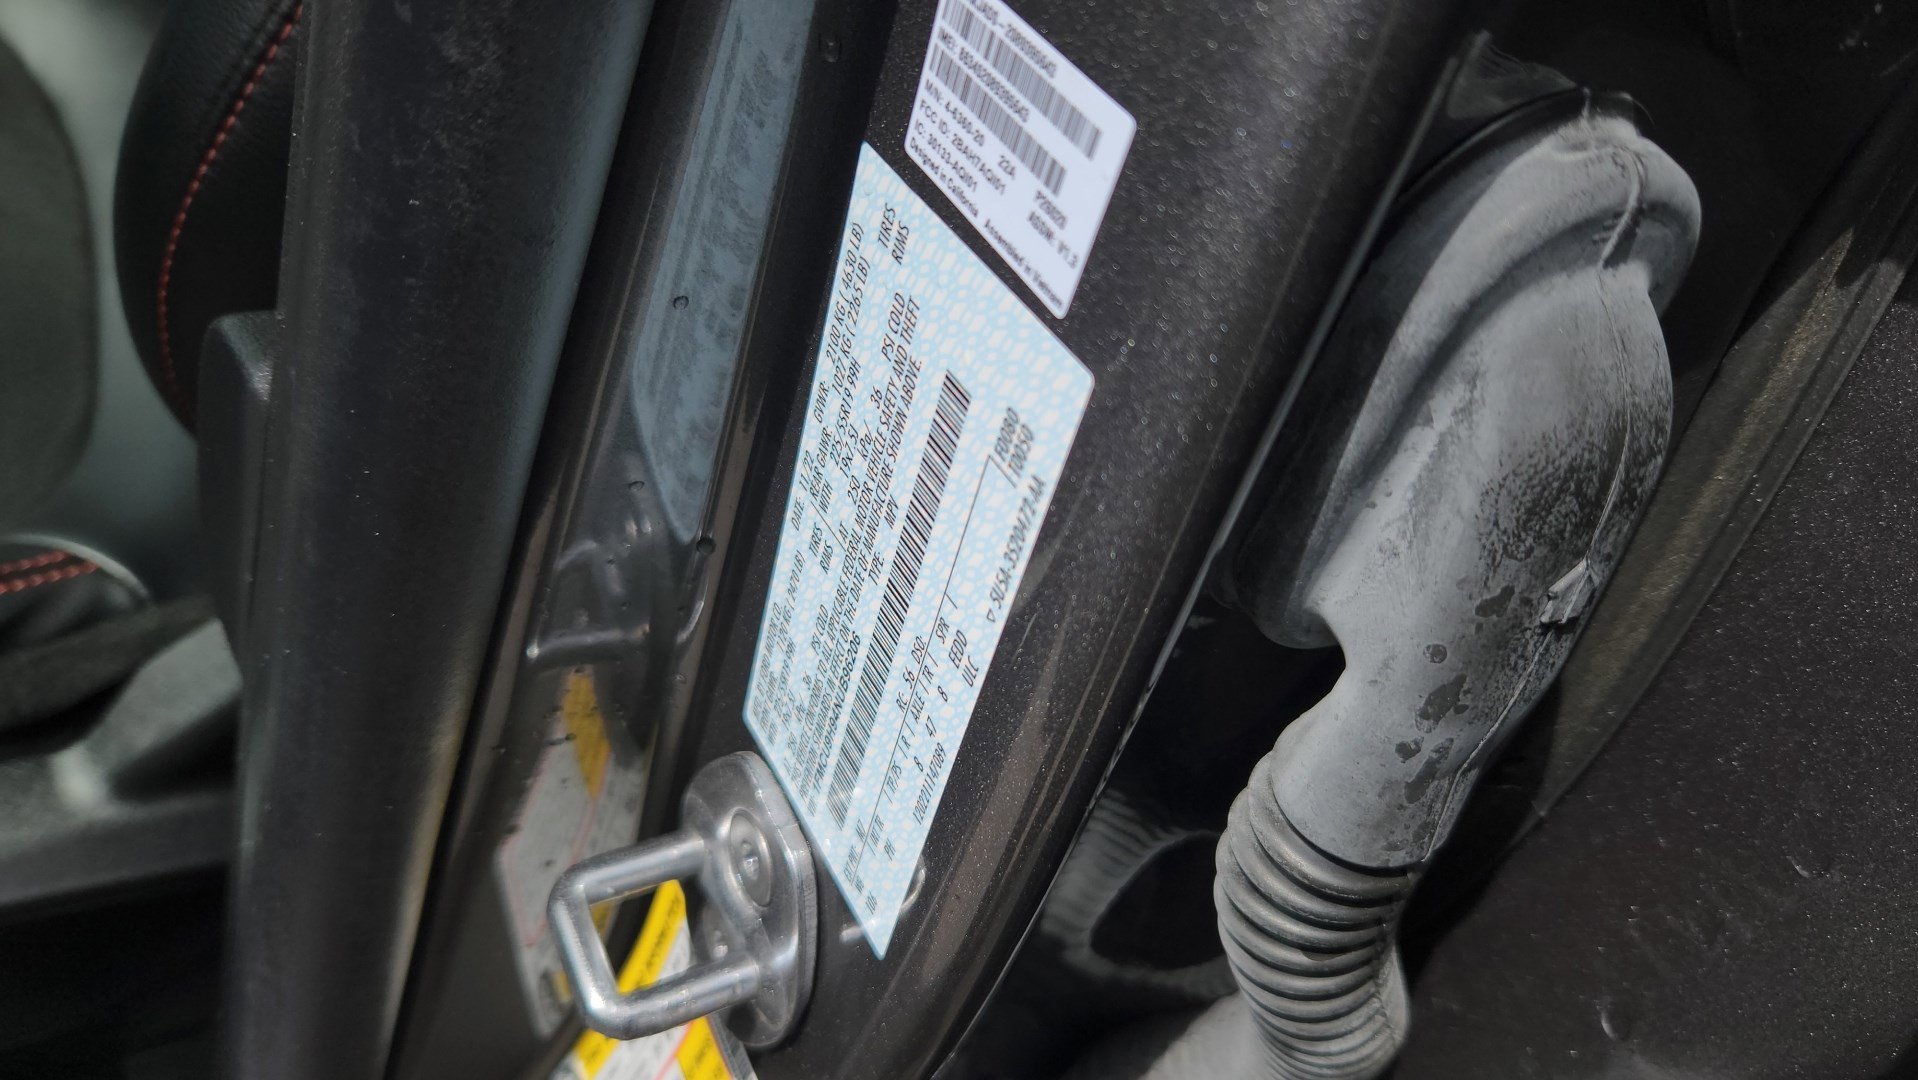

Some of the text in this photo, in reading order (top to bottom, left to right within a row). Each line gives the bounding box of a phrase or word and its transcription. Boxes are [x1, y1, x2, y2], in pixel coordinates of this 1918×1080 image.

[913, 117, 927, 140] IC:
[918, 97, 938, 126] FCC
[937, 116, 952, 140] ID:
[923, 77, 945, 107] M/N:
[996, 151, 1018, 181] 22A
[908, 135, 941, 179] Designed
[938, 167, 948, 184] in
[945, 175, 979, 219] California
[983, 216, 1025, 269] Assembled
[848, 218, 864, 253] LB)
[840, 246, 858, 293] 4630
[855, 252, 871, 287] LB)
[833, 298, 846, 327] KG
[846, 280, 864, 328] 2265
[818, 200, 896, 516] WITH 225/55R19 99H TIRES
[825, 321, 841, 366] 2100
[838, 218, 910, 480] 19x7.5J RIMS
[839, 331, 853, 361] KG
[831, 355, 847, 398] 1027
[812, 375, 830, 426] GVWR:
[837, 289, 906, 545] AT 250 kPa/ 36 PSI COLD
[815, 419, 833, 470] GAWR:
[790, 446, 816, 532] DATE: 11/22
[808, 463, 823, 503] REAR
[789, 293, 921, 789] THIS VEHICLE CONFORMS TO ALL APPLICABLE FEDERAL MOTOR VEHICLE SAFETY AND THEFT
[819, 537, 834, 576] RIMS
[793, 546, 806, 577] LB)
[797, 349, 922, 804] PREVENTION STANDARDS IN EFFECT ON THE DATE OF MANUFACTURE SHOWN ABOVE.
[786, 566, 800, 603] 2470
[766, 715, 778, 748] WITH
[784, 634, 797, 665] 99H
[808, 519, 823, 560] TIRES
[781, 602, 792, 628] KG
[814, 601, 829, 638] COLD
[934, 613, 950, 646] SPR
[764, 613, 778, 658] MOTOR
[775, 618, 789, 655] 1120
[810, 630, 822, 657] PSI
[811, 627, 861, 796] 1FMCU9H94NUB96206
[867, 545, 885, 589] TYPE:
[882, 492, 900, 531] MPV
[758, 649, 770, 684] FORD
[802, 668, 813, 692] 36
[894, 629, 927, 715] RC: 56 DSO:
[921, 662, 934, 687] TR
[961, 654, 979, 690] ULC
[755, 675, 765, 698] BY
[758, 696, 771, 734] FRONT
[908, 689, 925, 725] AXLE
[786, 728, 798, 756] 250
[864, 888, 878, 916] 106
[883, 836, 896, 862] PH
[923, 713, 938, 742] 47
[947, 626, 968, 670] EEDD
[886, 757, 903, 797] TP/PS
[869, 823, 881, 849] INT
[874, 811, 885, 833] TR
[842, 858, 854, 884] EXT
[854, 815, 867, 843] M7
